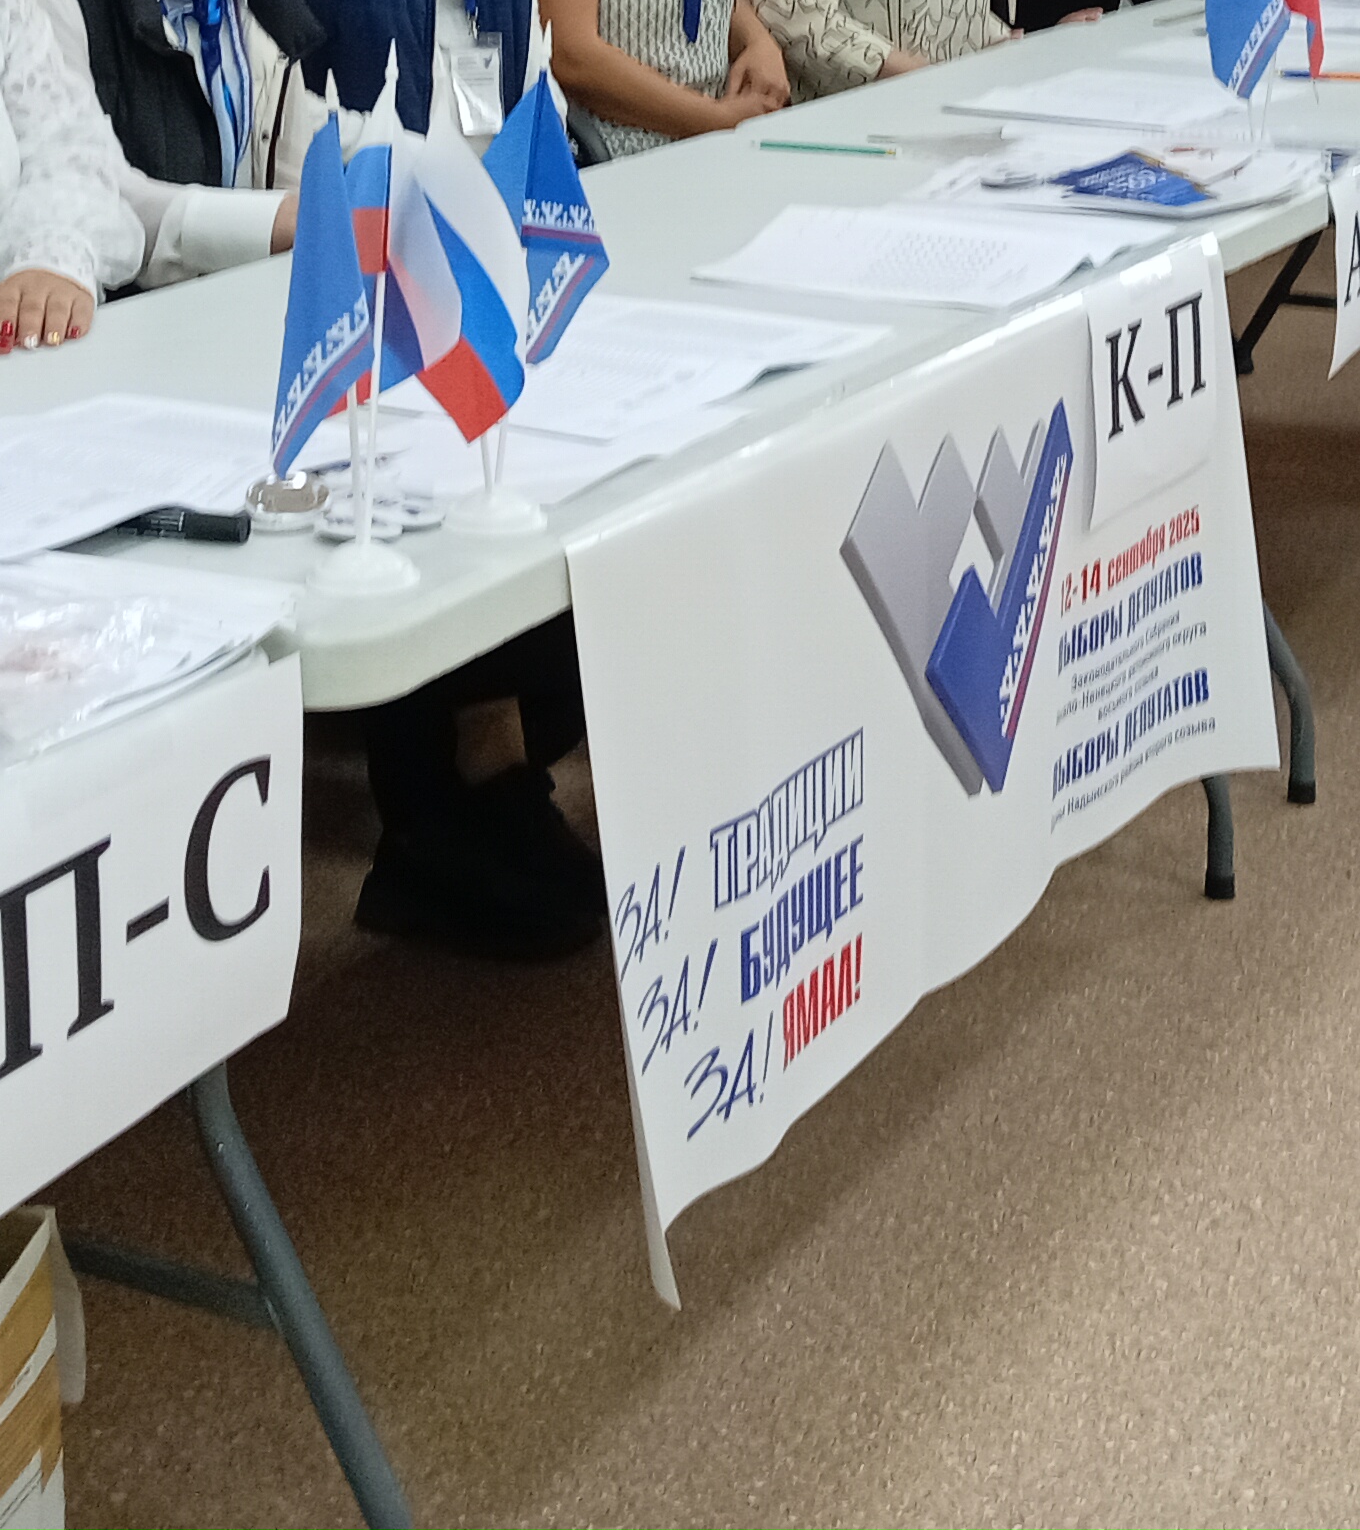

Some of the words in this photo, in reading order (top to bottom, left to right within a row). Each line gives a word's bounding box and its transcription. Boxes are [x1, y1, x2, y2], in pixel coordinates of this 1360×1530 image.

[1105, 289, 1207, 443] К-П
[1060, 557, 1102, 619] 12-14
[1107, 522, 1166, 591] сентября
[1169, 503, 1200, 549] 2025
[1126, 550, 1203, 638] ДЕПУТАТОВ
[1123, 667, 1210, 758] ДЕПУТАТОВ
[614, 844, 686, 983] ЗА!
[710, 726, 864, 912] ТРАДИЦИИ
[637, 937, 719, 1077] ЗА!
[740, 833, 864, 1006] БУДУЩЕЕ
[684, 1010, 774, 1142] ЗА!
[782, 931, 863, 1073] ЯМАЛ!
